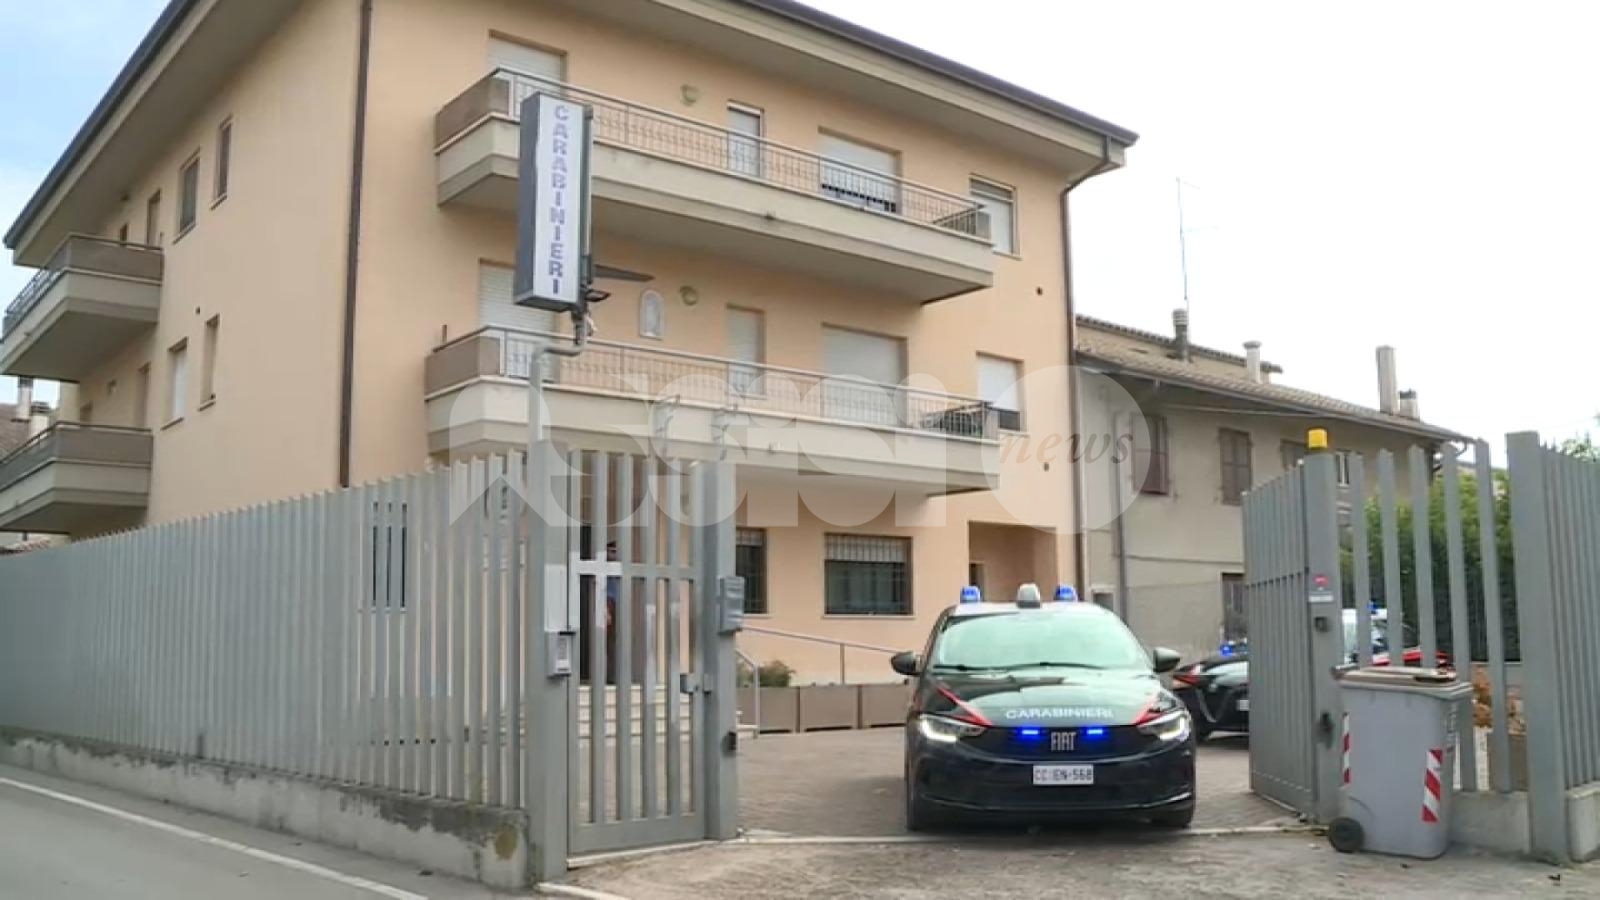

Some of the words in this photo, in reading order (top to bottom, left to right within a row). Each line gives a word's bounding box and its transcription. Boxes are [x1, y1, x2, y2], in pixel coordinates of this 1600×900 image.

[548, 104, 570, 295] CARABINIERI
[1006, 706, 1114, 720] CARABINIERI
[1050, 731, 1077, 752] FIAT
